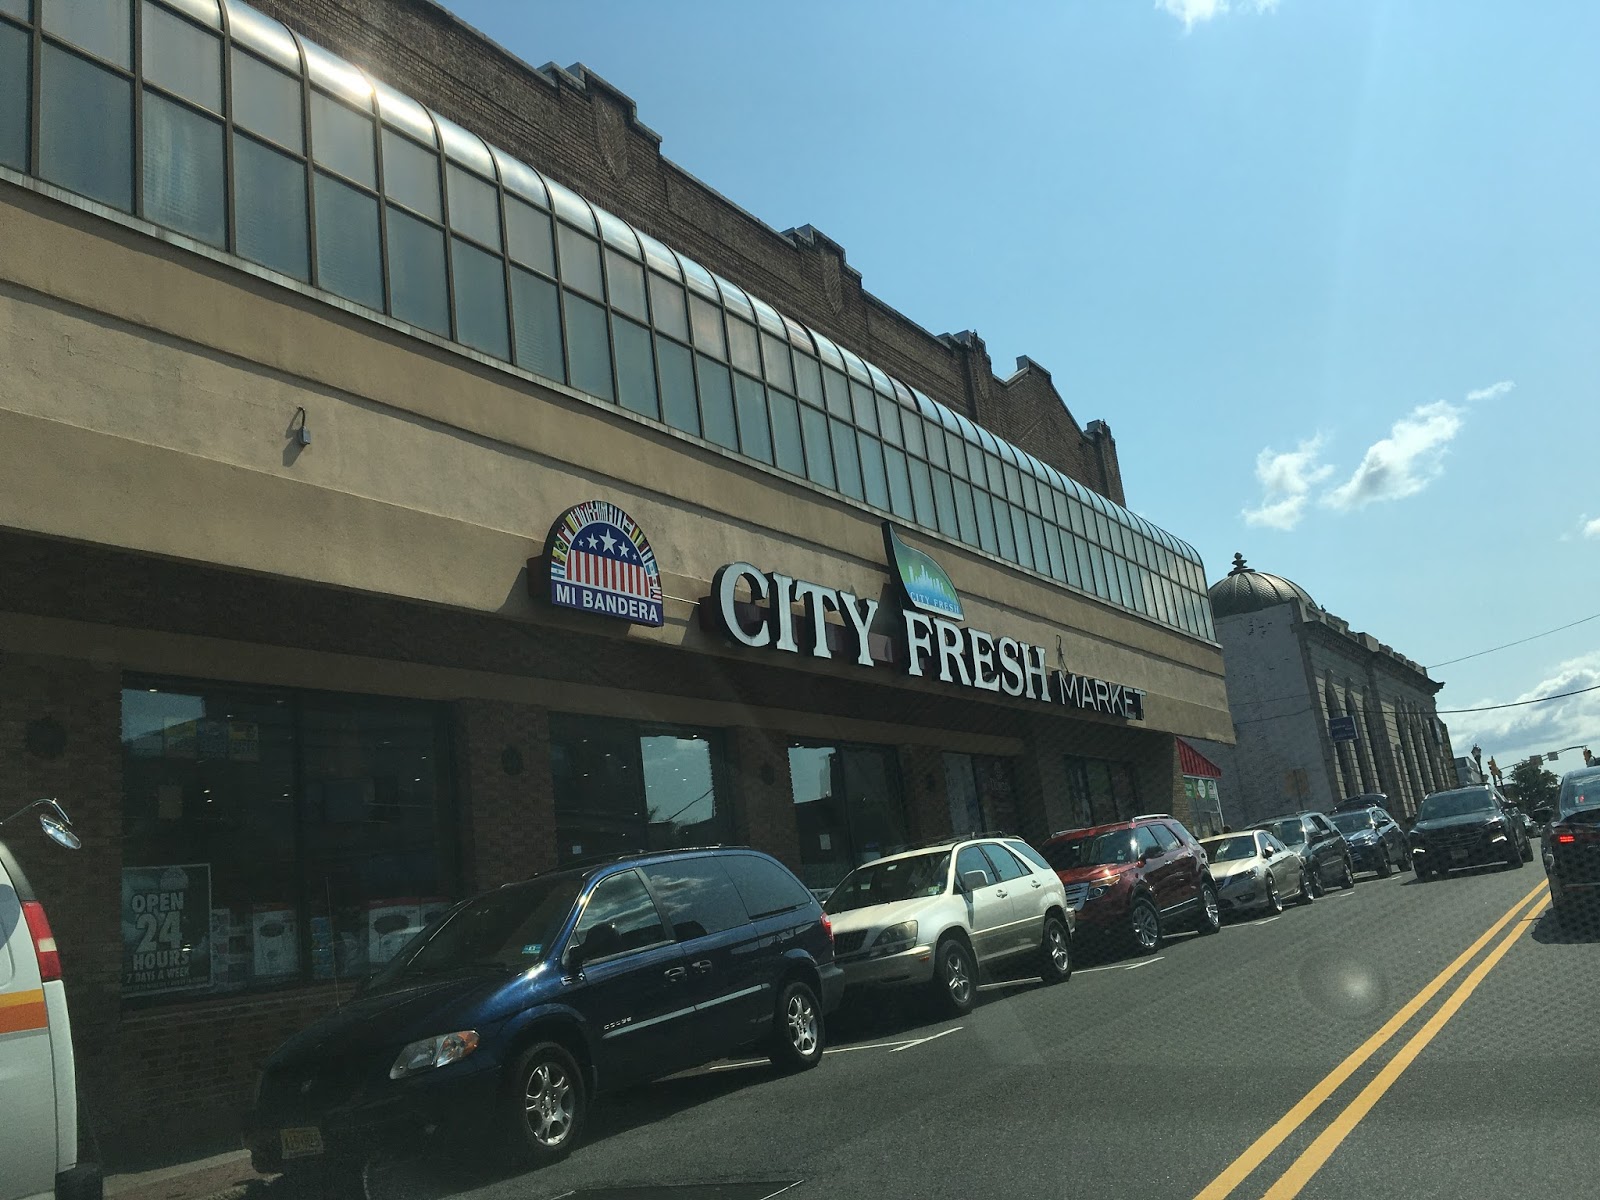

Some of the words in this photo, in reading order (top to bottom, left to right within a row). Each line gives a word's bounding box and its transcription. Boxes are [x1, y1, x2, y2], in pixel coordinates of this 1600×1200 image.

[556, 583, 576, 605] MI
[582, 589, 659, 622] BANDERA
[910, 591, 930, 605] CITY
[933, 598, 960, 614] FRESH
[714, 561, 878, 667] CITY
[902, 609, 1051, 702] FRESH
[1056, 670, 1147, 720] MARKET
[131, 891, 184, 913] OPEN
[136, 910, 182, 953] 24
[133, 949, 190, 971] HOURS
[126, 973, 133, 984] 7
[135, 970, 156, 983] DAYS
[158, 969, 165, 980] A
[167, 966, 190, 979] WEEK
